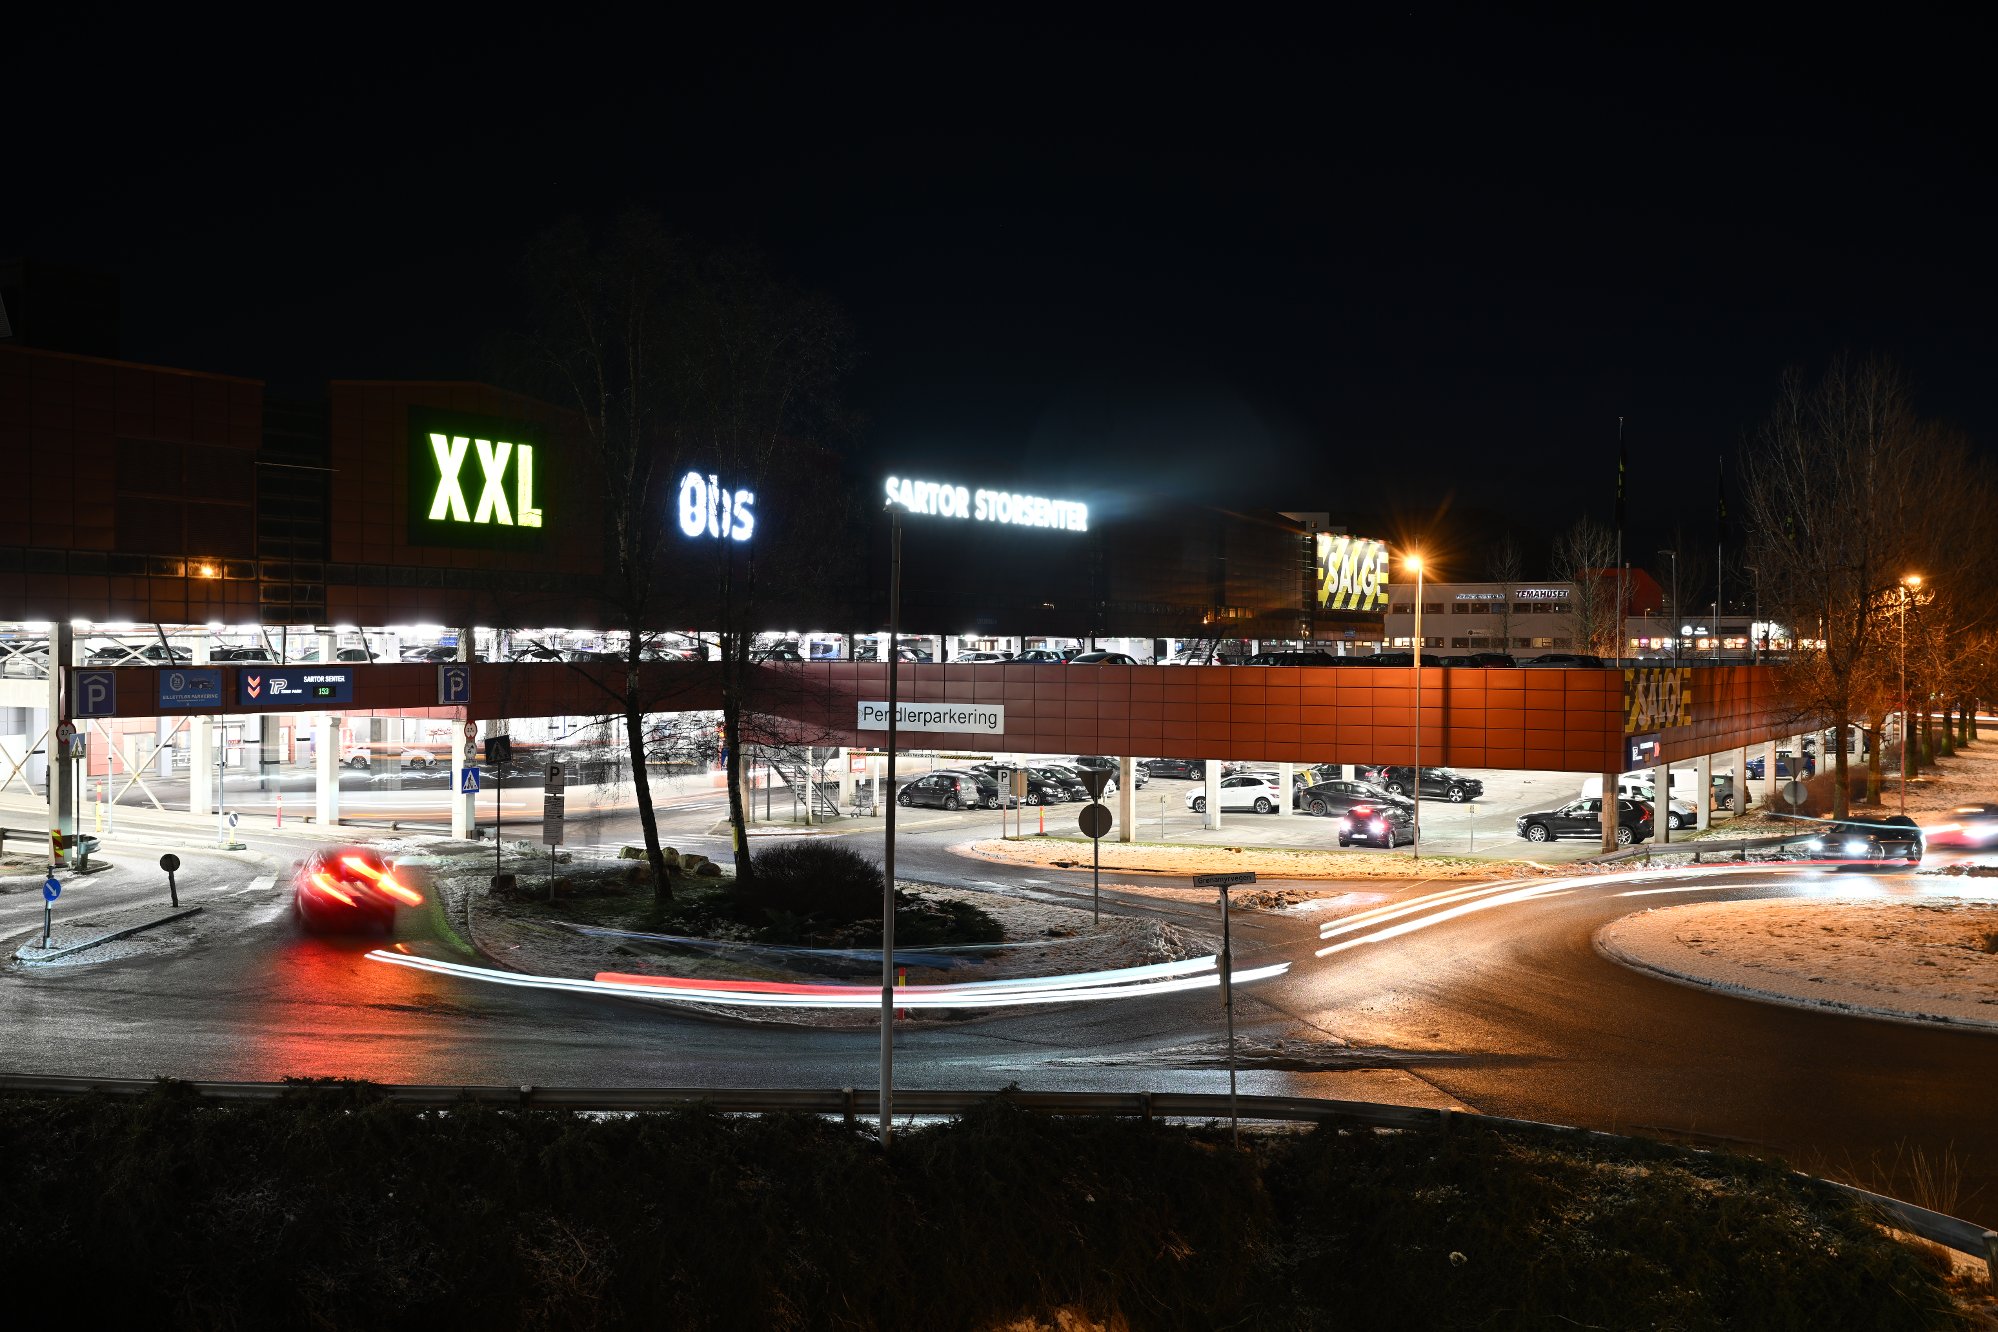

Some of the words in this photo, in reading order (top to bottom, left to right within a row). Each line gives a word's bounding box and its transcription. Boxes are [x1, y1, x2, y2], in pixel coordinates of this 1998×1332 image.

[428, 432, 543, 528] XXL
[679, 471, 755, 541] Obs
[884, 476, 970, 519] SARTOR
[974, 488, 1088, 532] STORSENTER
[1327, 551, 1381, 597] SALG!
[1515, 589, 1569, 599] TEMAHUSET
[303, 675, 325, 683] SARTOR
[318, 687, 330, 695] 153
[450, 676, 464, 701] P
[87, 684, 106, 713] P
[863, 705, 998, 729] Pendlerparkering
[549, 765, 561, 782] P
[1001, 771, 1008, 783] P
